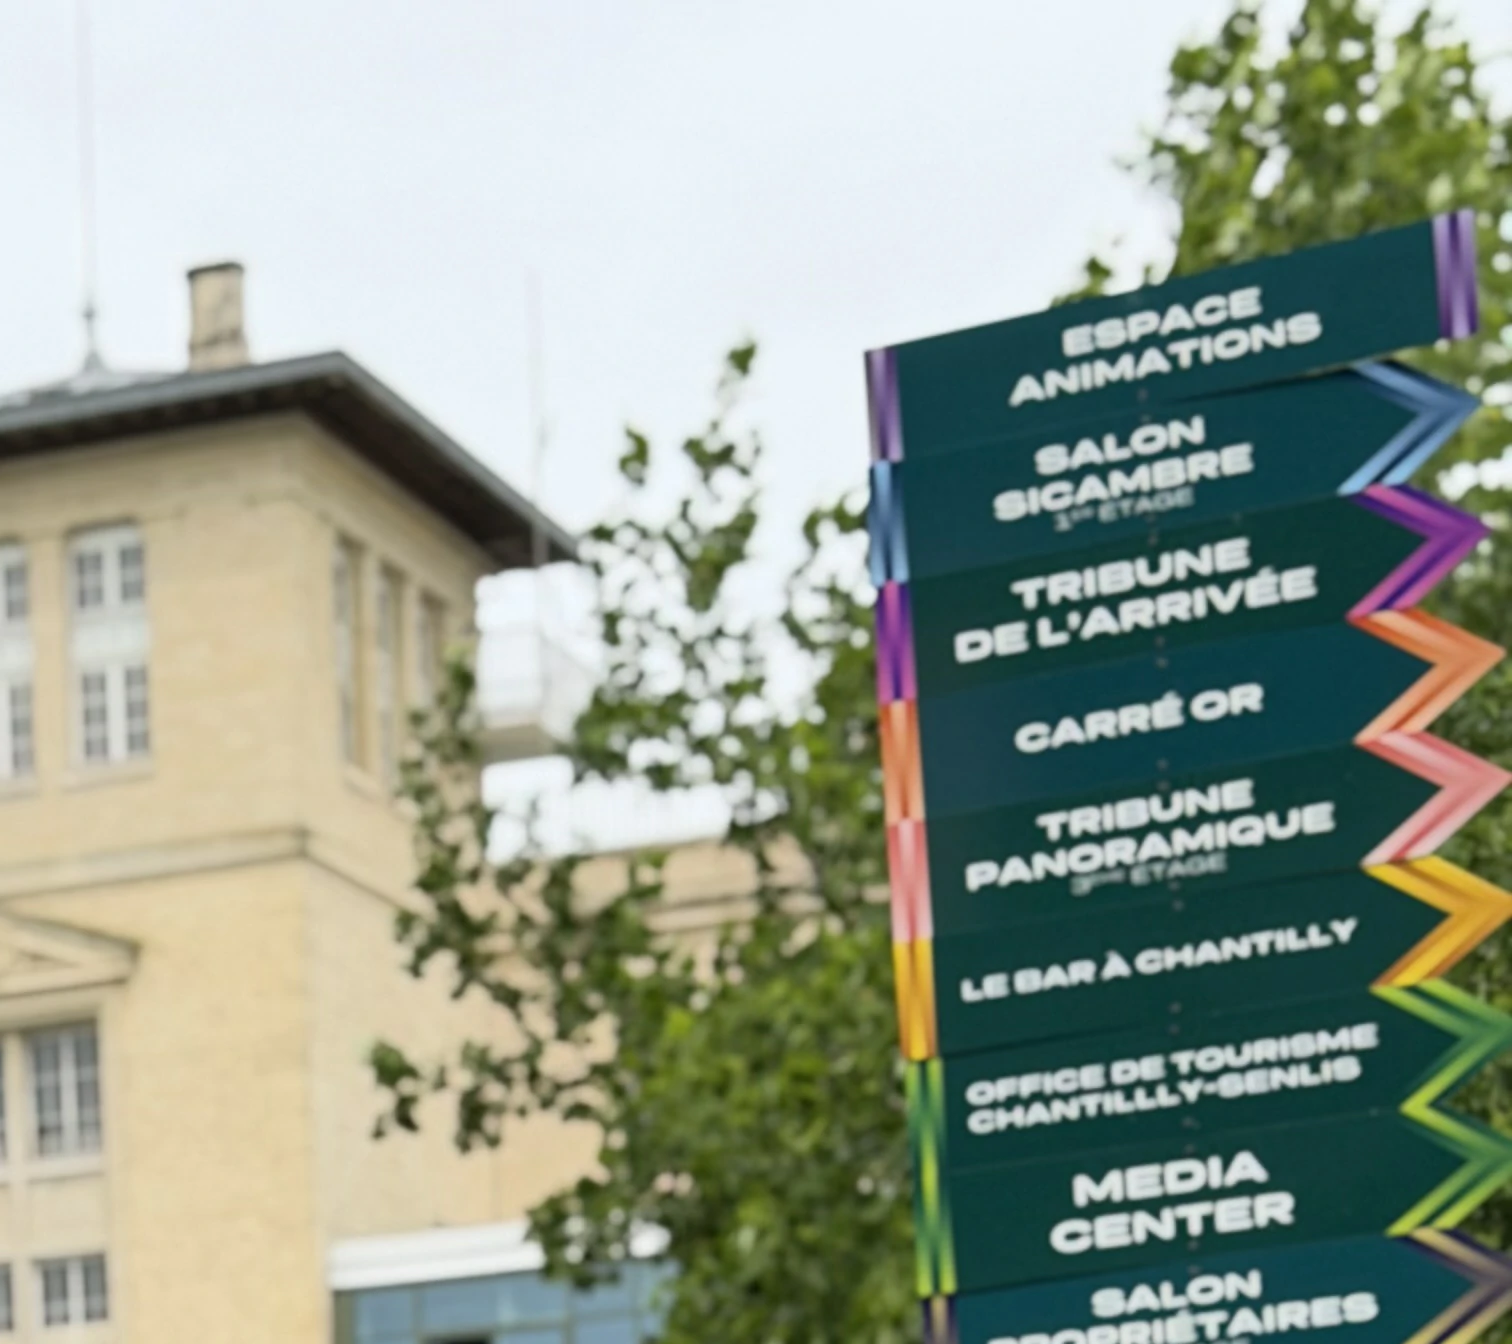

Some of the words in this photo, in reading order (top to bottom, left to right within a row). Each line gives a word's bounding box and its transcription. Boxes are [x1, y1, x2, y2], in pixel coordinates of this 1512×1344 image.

[1062, 286, 1263, 357] ESPACE
[1009, 312, 1323, 406] ANIMATIONS
[1034, 416, 1206, 475] SALON
[992, 443, 1254, 521] SICAMBRE
[1011, 537, 1251, 609] TRIBUNE
[954, 621, 1029, 663] DE
[1036, 566, 1318, 648] L'ARRIVÉE
[1014, 691, 1185, 753] CARRÉ
[1190, 683, 1265, 721] OR
[1036, 778, 1255, 841] TRIBUNE
[965, 802, 1336, 892] PANORAMIQUE
[961, 972, 1009, 1002] LE
[1013, 959, 1097, 995] BAR
[1101, 950, 1132, 980] À
[1134, 916, 1358, 975] CHANTILLY
[965, 1064, 1107, 1107] OFFICE
[1110, 1055, 1166, 1084] DE
[1169, 1023, 1379, 1075] TOURISME
[1072, 1151, 1269, 1208] MEDIA
[1049, 1191, 1296, 1254] CENTER
[1090, 1268, 1262, 1318] SALON
